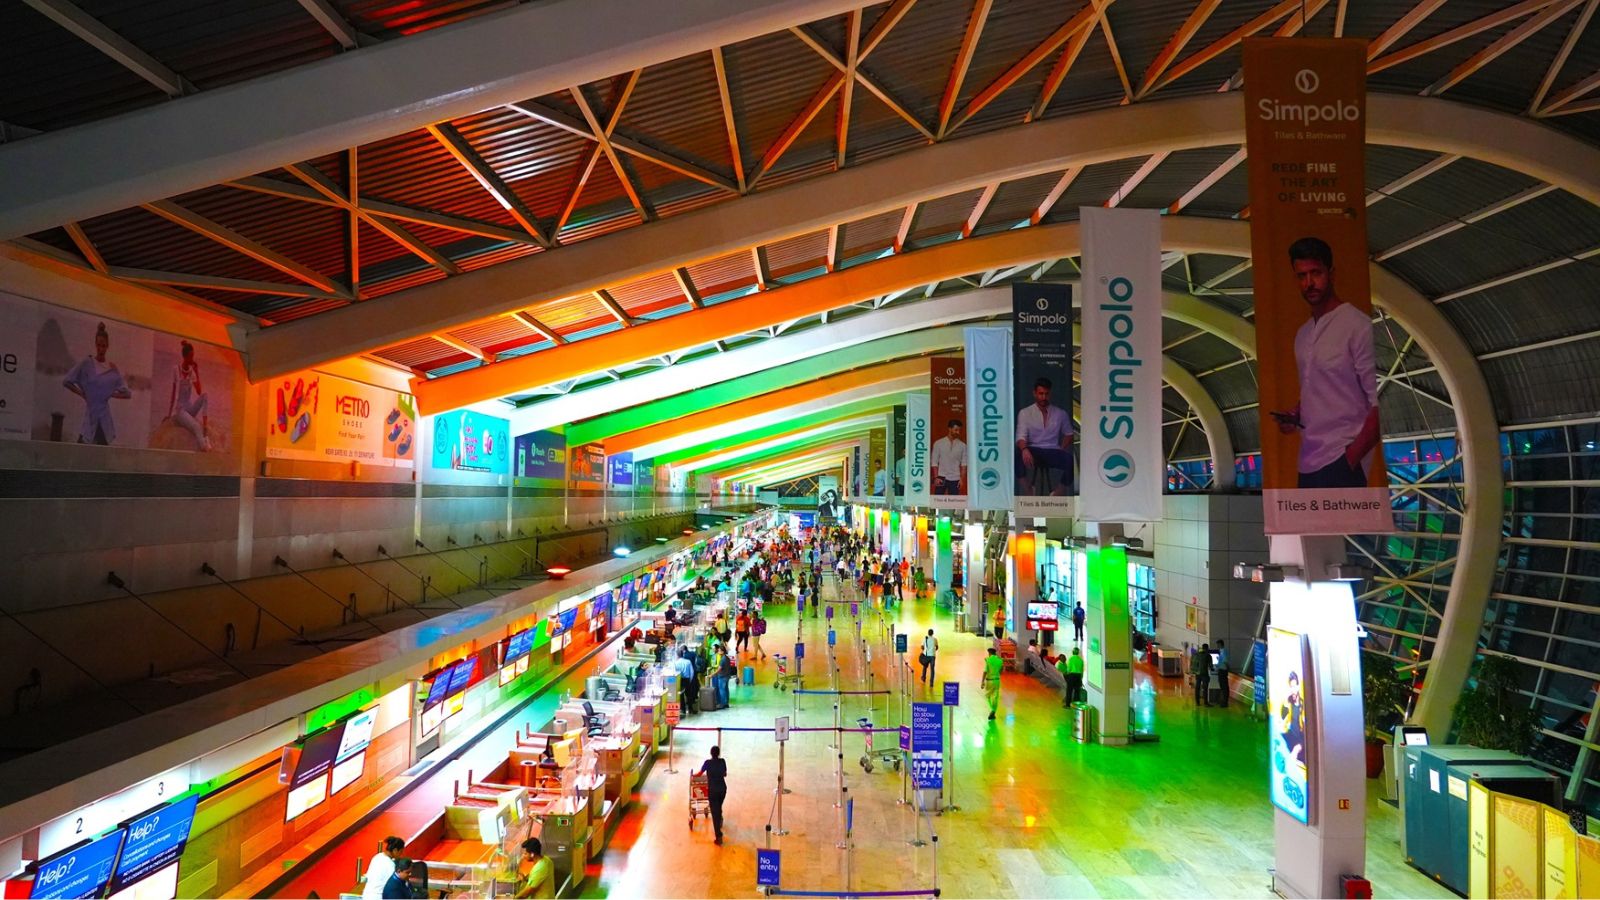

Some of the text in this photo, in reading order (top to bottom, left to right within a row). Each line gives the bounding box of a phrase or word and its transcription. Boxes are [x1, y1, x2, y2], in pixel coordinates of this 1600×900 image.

[1258, 98, 1359, 126] Simpolo
[1274, 131, 1295, 140] Tiles
[1272, 163, 1336, 173] REDEFINE
[1281, 177, 1336, 187] THE ART
[1278, 192, 1346, 202] OF LIVING
[1018, 312, 1067, 326] Simpolo
[1100, 277, 1142, 440] Simpolo
[934, 376, 967, 386] Simpolo
[336, 395, 370, 418] METRO
[977, 367, 1003, 462] Simpolo
[911, 418, 927, 477] Simpolo
[1277, 499, 1380, 511] Tiles & Bathware
[158, 782, 164, 796] 3
[76, 818, 83, 834] 2
[128, 816, 159, 844] Help?
[36, 856, 76, 889] Help?
[760, 864, 778, 872] entry
